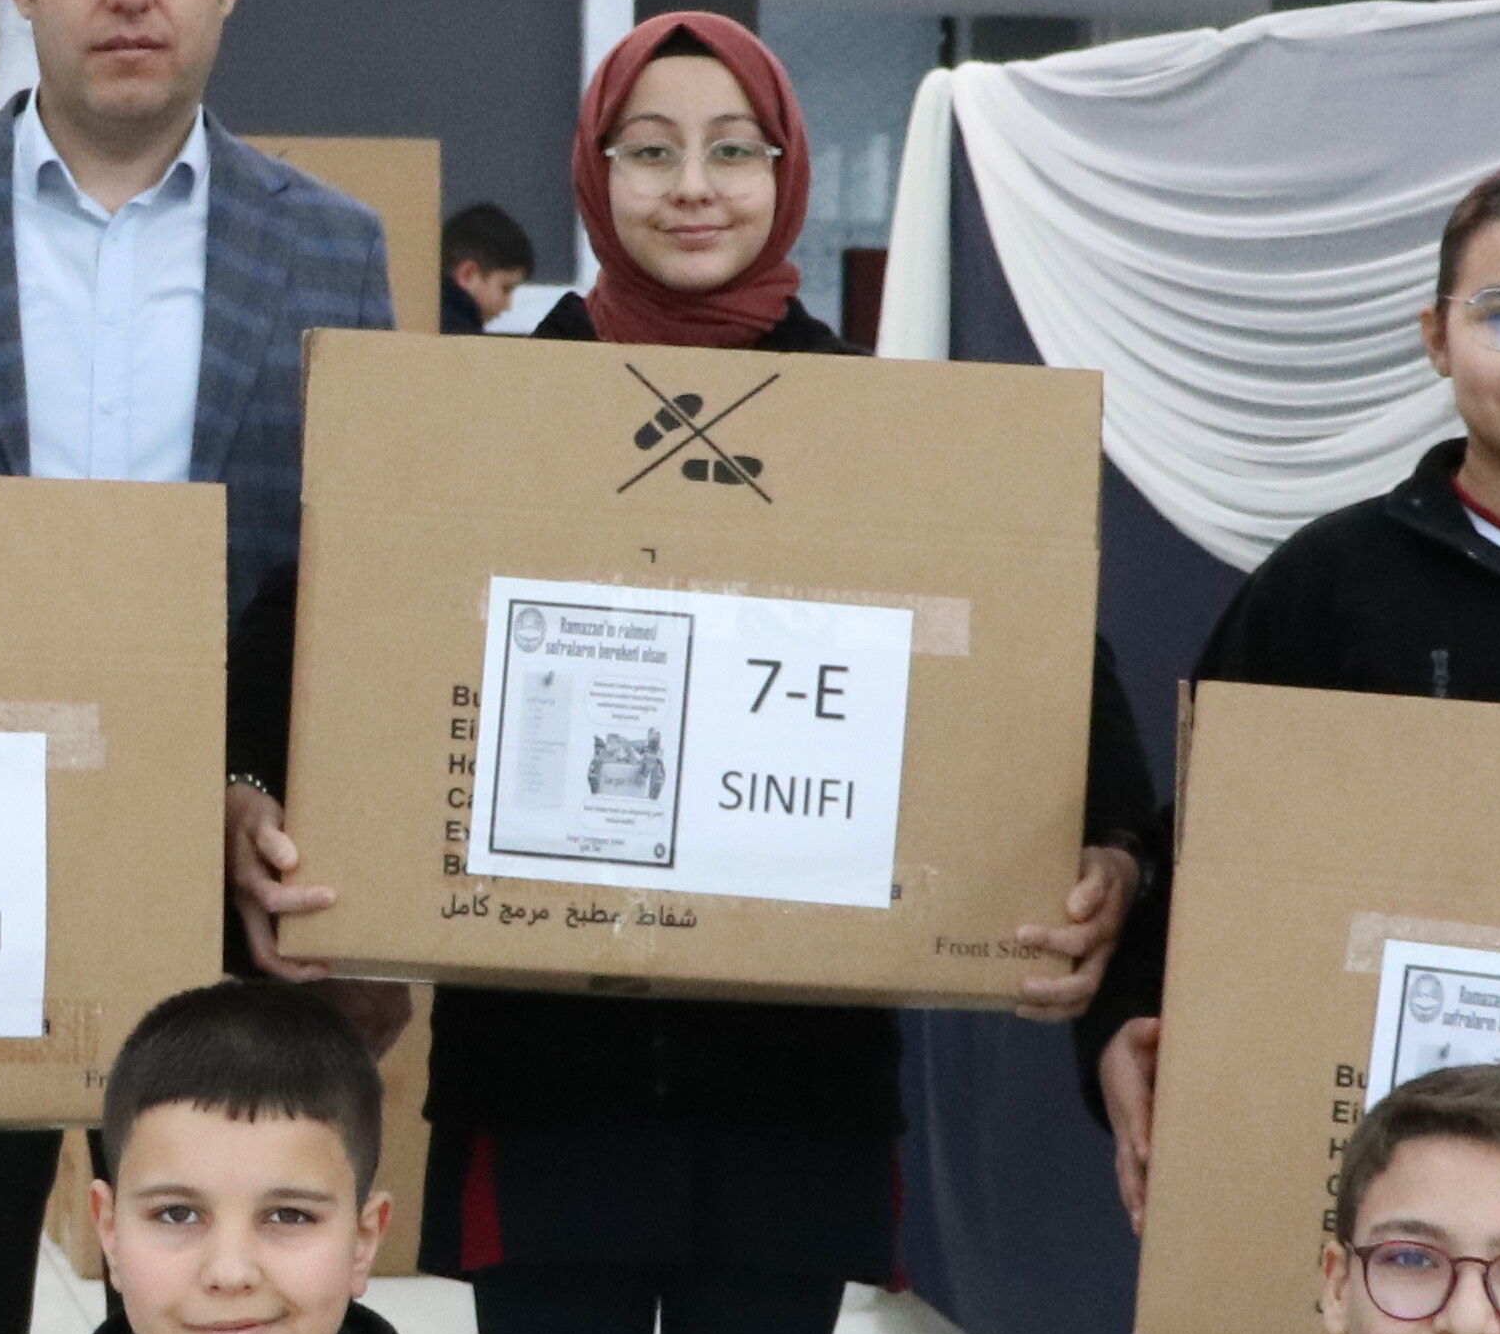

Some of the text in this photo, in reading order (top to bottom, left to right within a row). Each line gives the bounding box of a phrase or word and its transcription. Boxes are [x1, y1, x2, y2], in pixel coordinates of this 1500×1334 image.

[747, 658, 849, 721] 7-E
[718, 770, 854, 820] SINIFI
[935, 935, 990, 957] Front
